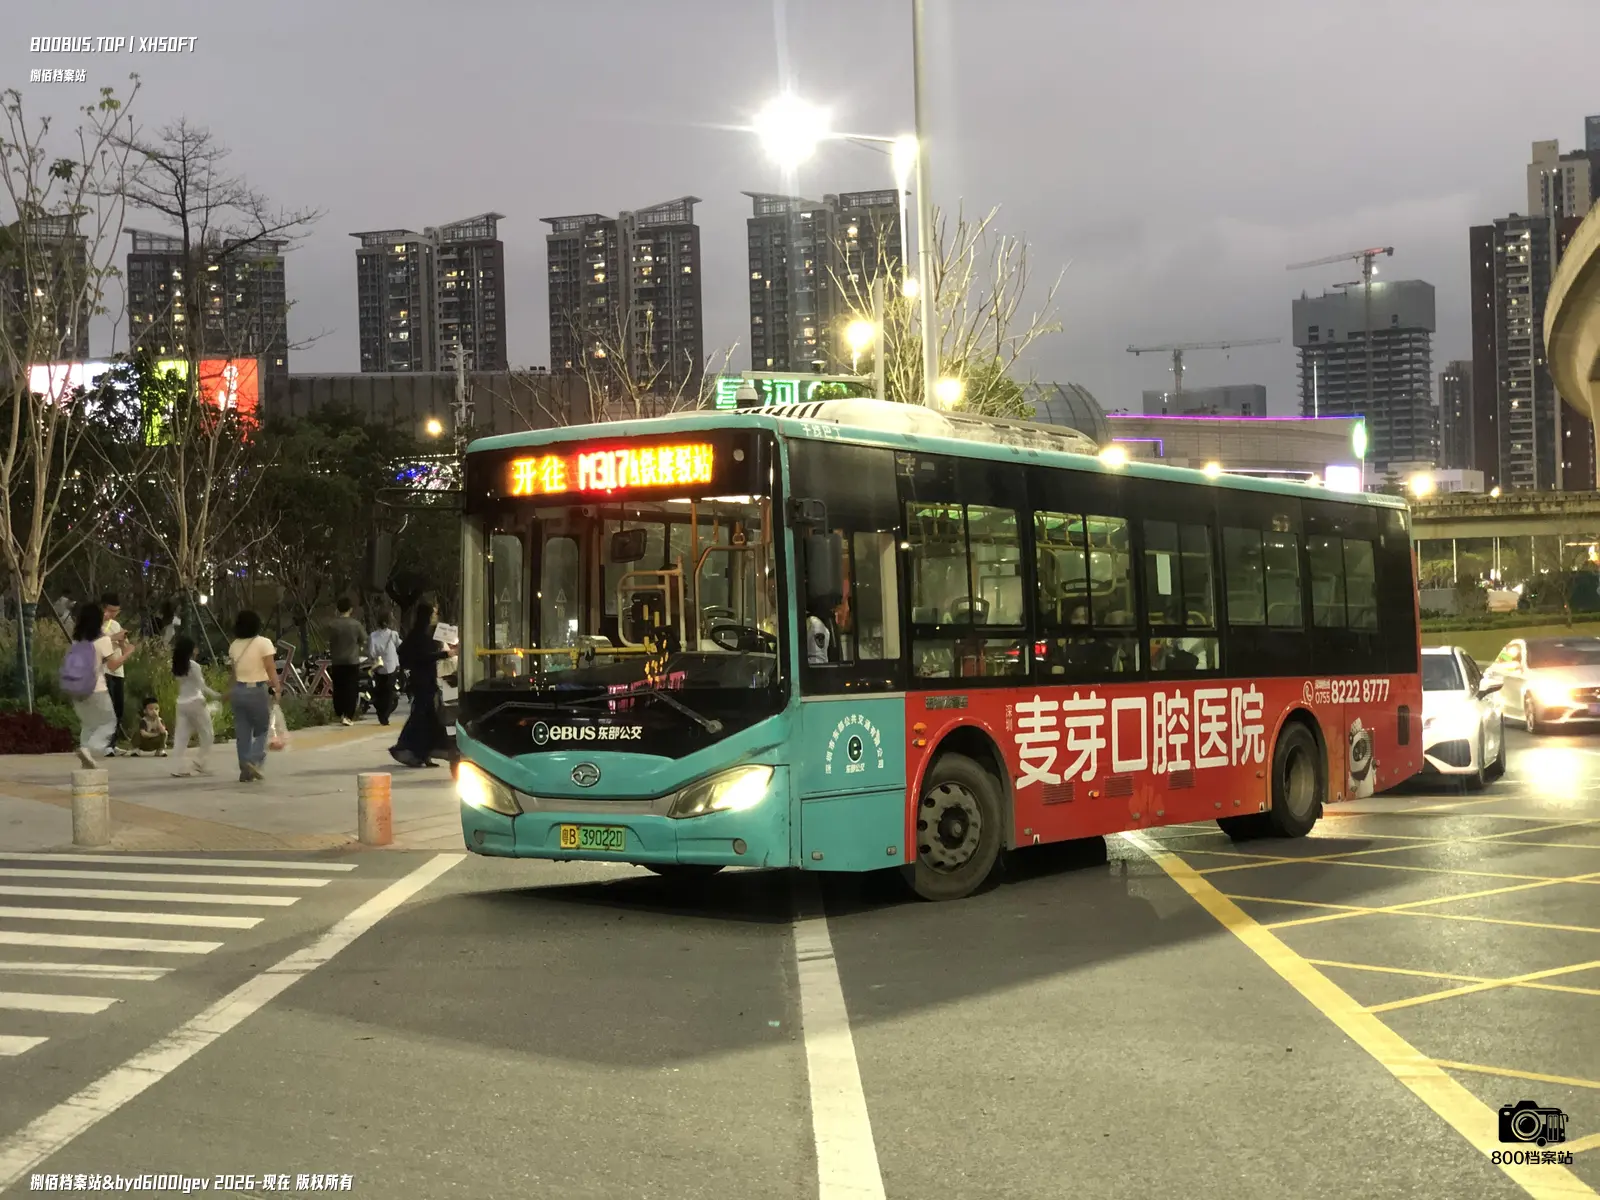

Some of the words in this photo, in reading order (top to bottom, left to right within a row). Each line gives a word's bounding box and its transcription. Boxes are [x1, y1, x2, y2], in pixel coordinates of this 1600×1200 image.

[512, 455, 568, 496] 开往
[1315, 691, 1331, 704] 0755
[1331, 680, 1361, 704] 8222
[1362, 679, 1390, 703] 8777
[597, 726, 642, 740] 东部公交
[1014, 682, 1266, 791] 麦芽口腔医院
